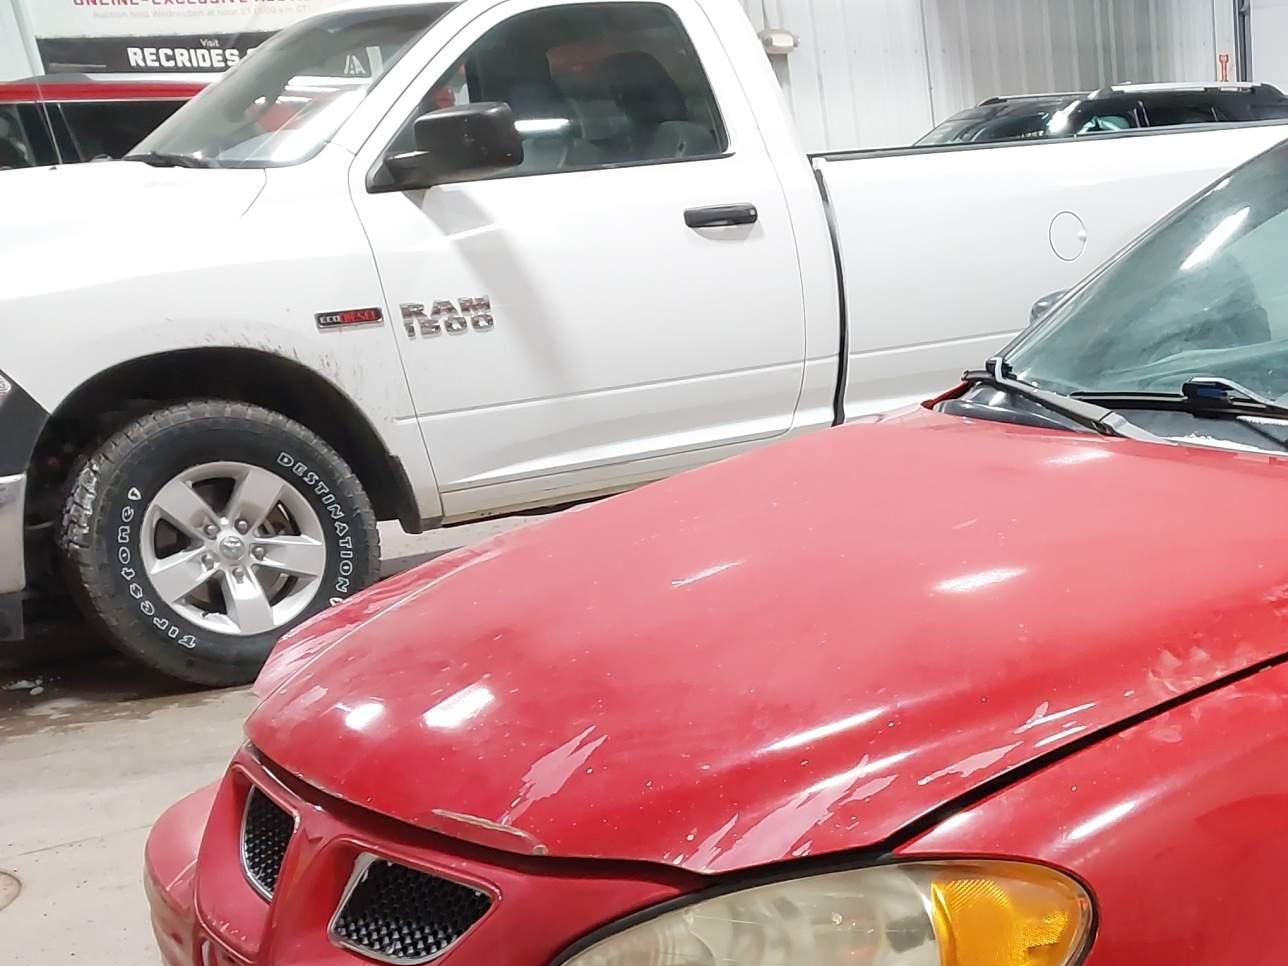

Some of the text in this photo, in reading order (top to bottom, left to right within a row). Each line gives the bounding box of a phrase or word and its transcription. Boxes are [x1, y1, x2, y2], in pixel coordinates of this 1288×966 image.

[200, 38, 219, 47] Visit
[127, 47, 256, 67] RECRIDES
[400, 296, 490, 319] RAM
[403, 314, 494, 338] 1500
[277, 451, 353, 593] DESTINATION
